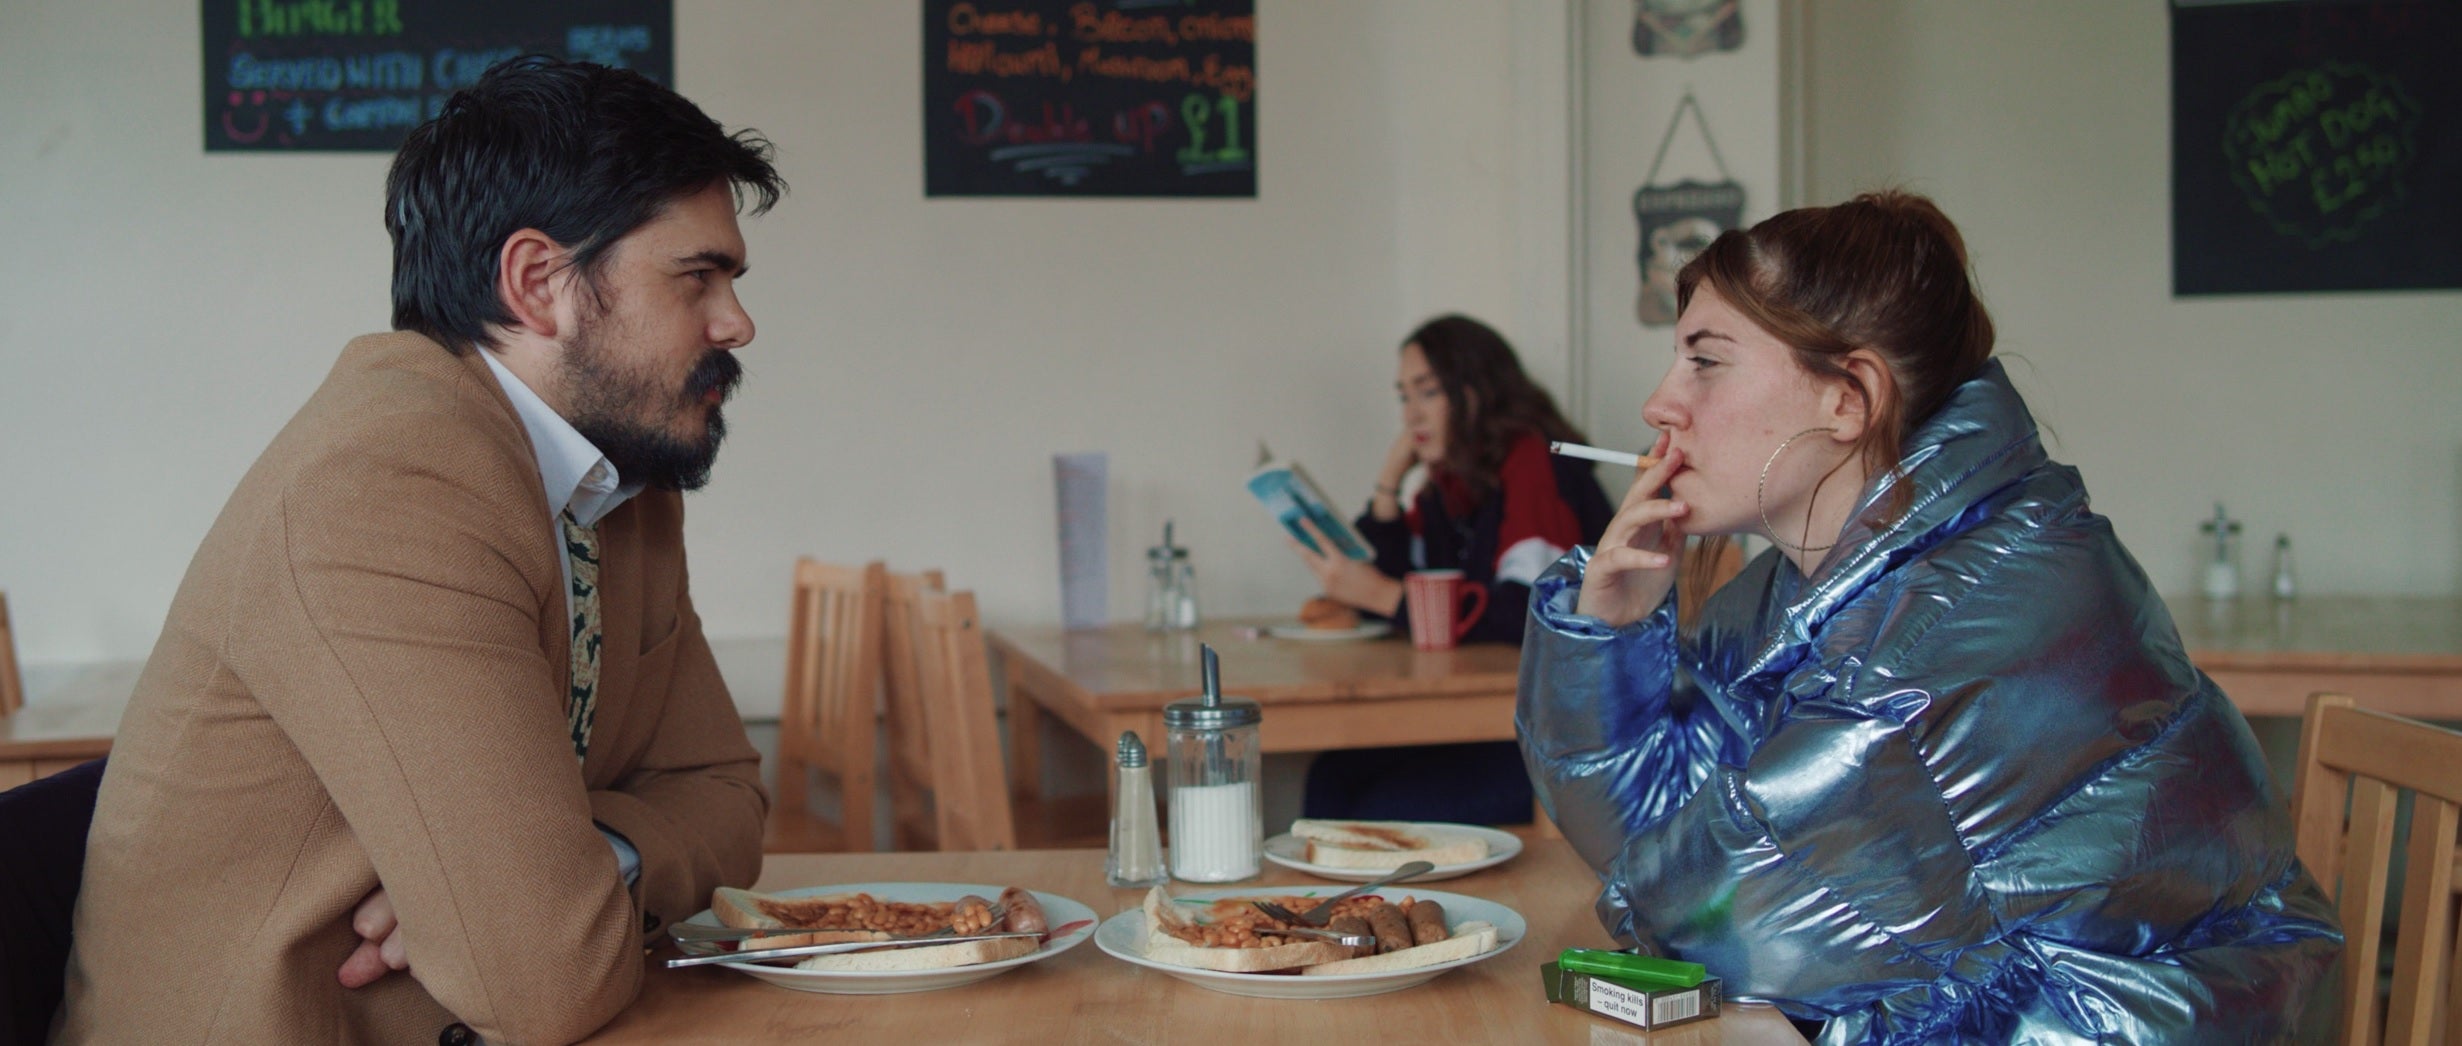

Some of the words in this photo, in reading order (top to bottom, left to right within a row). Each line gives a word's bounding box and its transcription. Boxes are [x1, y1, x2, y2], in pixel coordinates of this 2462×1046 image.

[954, 89, 1094, 145] Double
[1176, 93, 1248, 162] £1
[1592, 982, 1625, 1003] Smoking
[1628, 992, 1643, 1006] kills
[1604, 1000, 1619, 1012] quit
[1621, 1006, 1637, 1017] now
